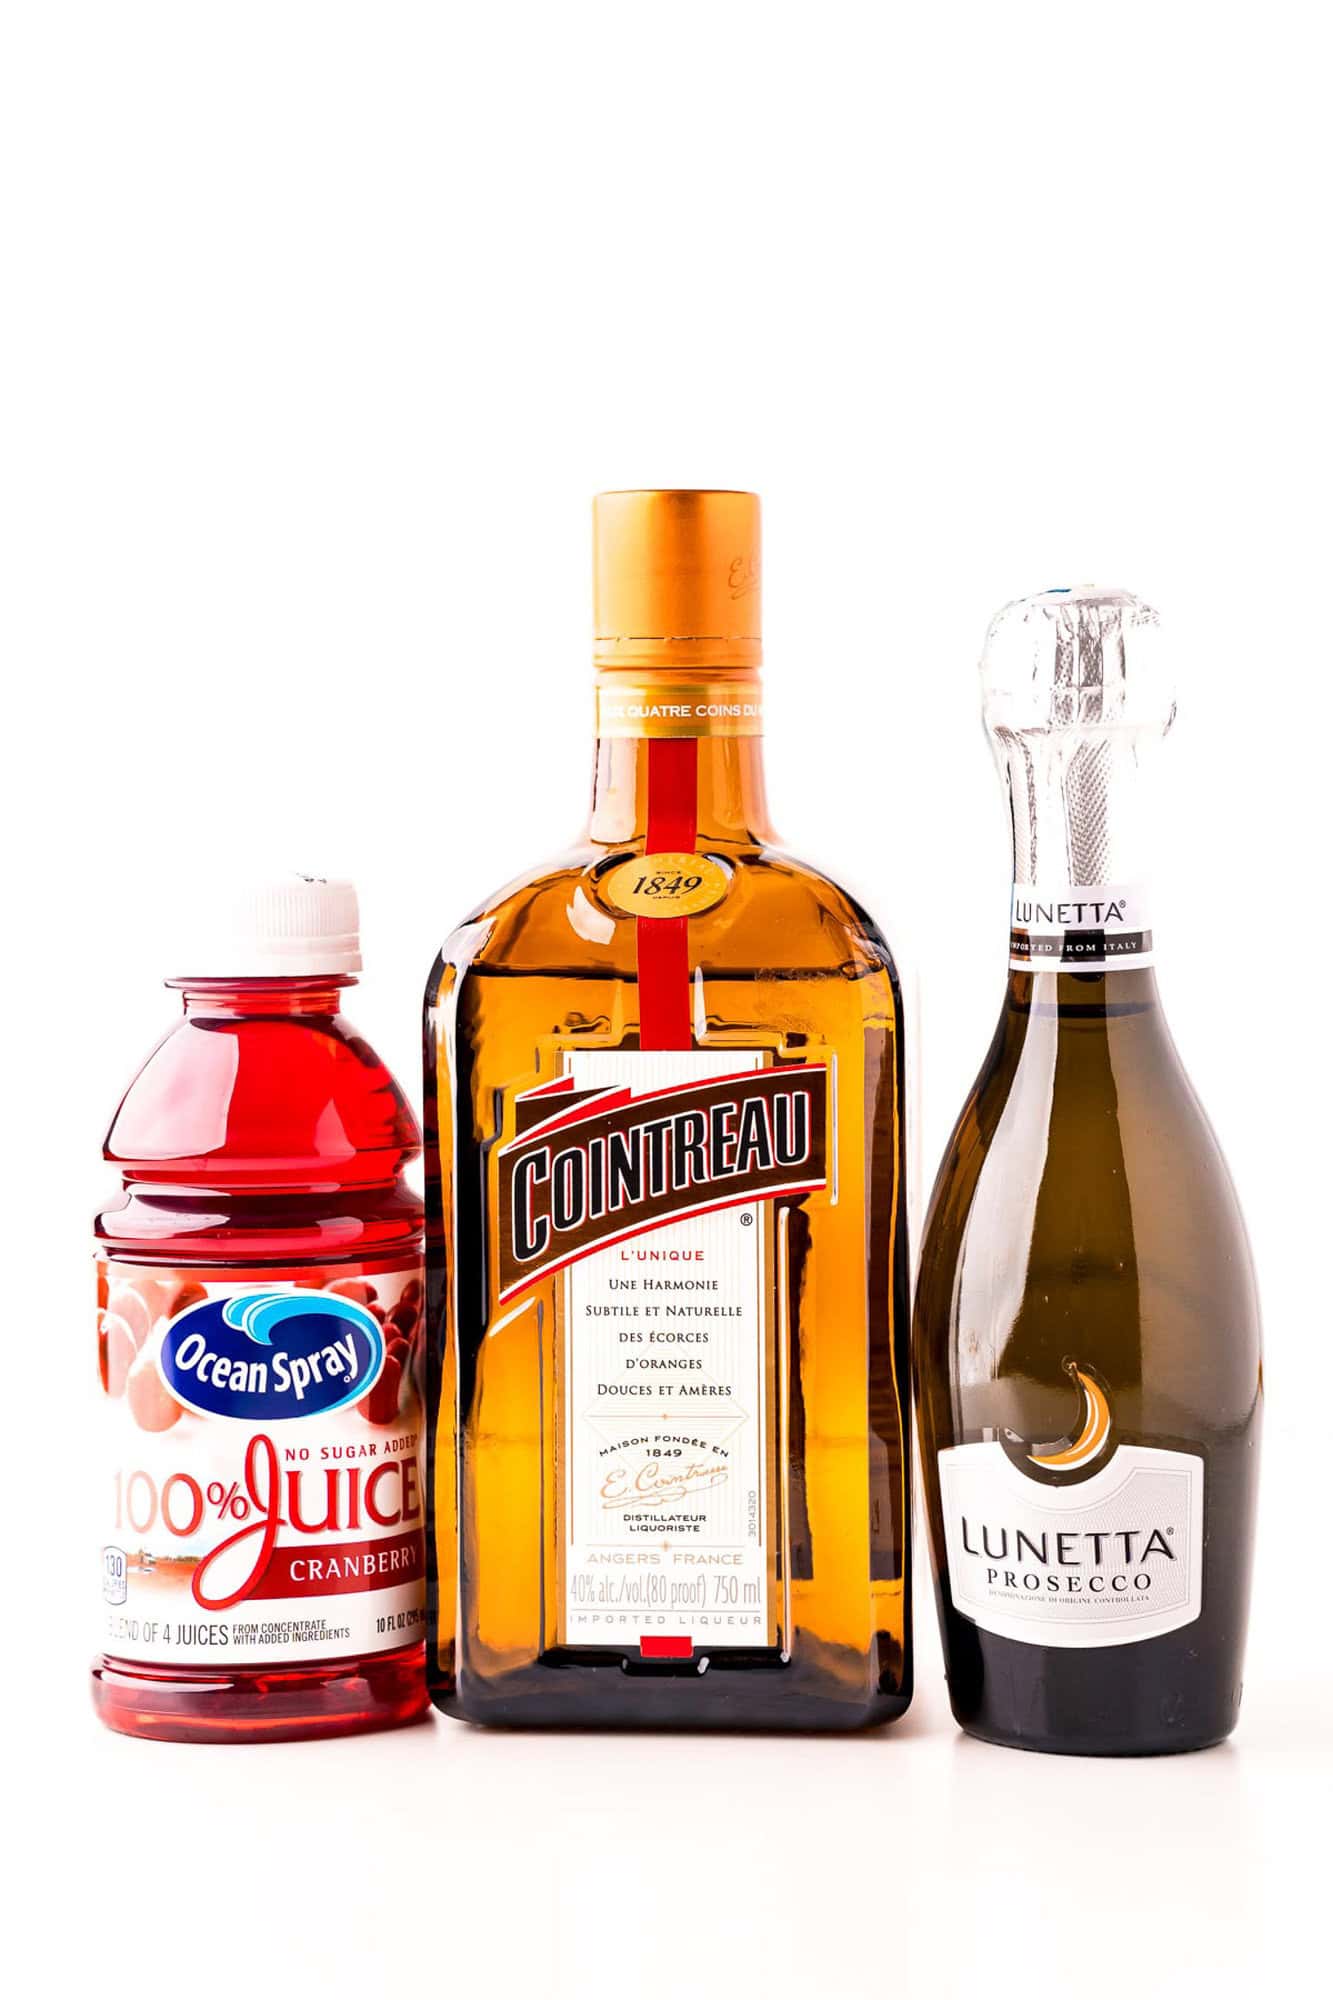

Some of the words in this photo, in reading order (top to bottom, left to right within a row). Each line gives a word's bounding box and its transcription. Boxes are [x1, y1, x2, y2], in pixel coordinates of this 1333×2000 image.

[627, 705, 692, 718] QUATRE
[695, 705, 742, 717] COINS
[632, 876, 703, 895] 1849
[1059, 944, 1096, 952] FROM
[1104, 942, 1137, 951] ITALY
[512, 1091, 811, 1263] COINTREAU
[621, 1250, 705, 1261] L'UNIQUE
[609, 1280, 637, 1290] UNE
[643, 1280, 719, 1290] HARMONIE
[585, 1305, 640, 1317] SUBTILE
[645, 1307, 660, 1316] ET
[665, 1306, 743, 1317] NATURELLE
[619, 1332, 643, 1343] DES
[649, 1330, 709, 1343] ÉCORCES
[175, 1333, 268, 1393] Ocean
[271, 1333, 358, 1400] Spray
[626, 1358, 702, 1369] D'ORANGES
[597, 1384, 652, 1396] DOUCES
[659, 1385, 673, 1395] ET
[679, 1384, 732, 1395] AMÈRES
[285, 1448, 309, 1461] NO
[320, 1445, 377, 1460] SUGAR
[600, 1436, 649, 1457] MAISON
[654, 1435, 707, 1449] FONDÉE
[712, 1446, 729, 1457] EN
[646, 1449, 682, 1457] 1849
[112, 1470, 250, 1537] 100%
[192, 1434, 420, 1611] JUICE
[623, 1514, 706, 1522] DISTILLATEUR
[106, 1555, 122, 1577] 130
[290, 1546, 416, 1581] CRANBERRY
[587, 1553, 661, 1564] ANGERS
[673, 1553, 743, 1565] FRANCE
[986, 1567, 1152, 1593] PROSECCO
[570, 1574, 595, 1603] 40%
[671, 1573, 706, 1609] proof)
[713, 1575, 738, 1605] 750
[743, 1575, 760, 1603] ml
[233, 1624, 258, 1634] FROM
[261, 1619, 327, 1634] CONCENTRATE
[376, 1618, 385, 1633] 10
[387, 1616, 396, 1632] FL
[397, 1612, 405, 1629] OZ
[569, 1615, 666, 1624] IMPORTED
[679, 1616, 761, 1625] LIQUEUR
[143, 1622, 159, 1643] OF
[162, 1624, 171, 1644] 4
[175, 1624, 229, 1646] JUICES
[233, 1633, 256, 1645] WITH
[258, 1632, 289, 1644] ADDED
[292, 1627, 350, 1642] INGREDIENTS
